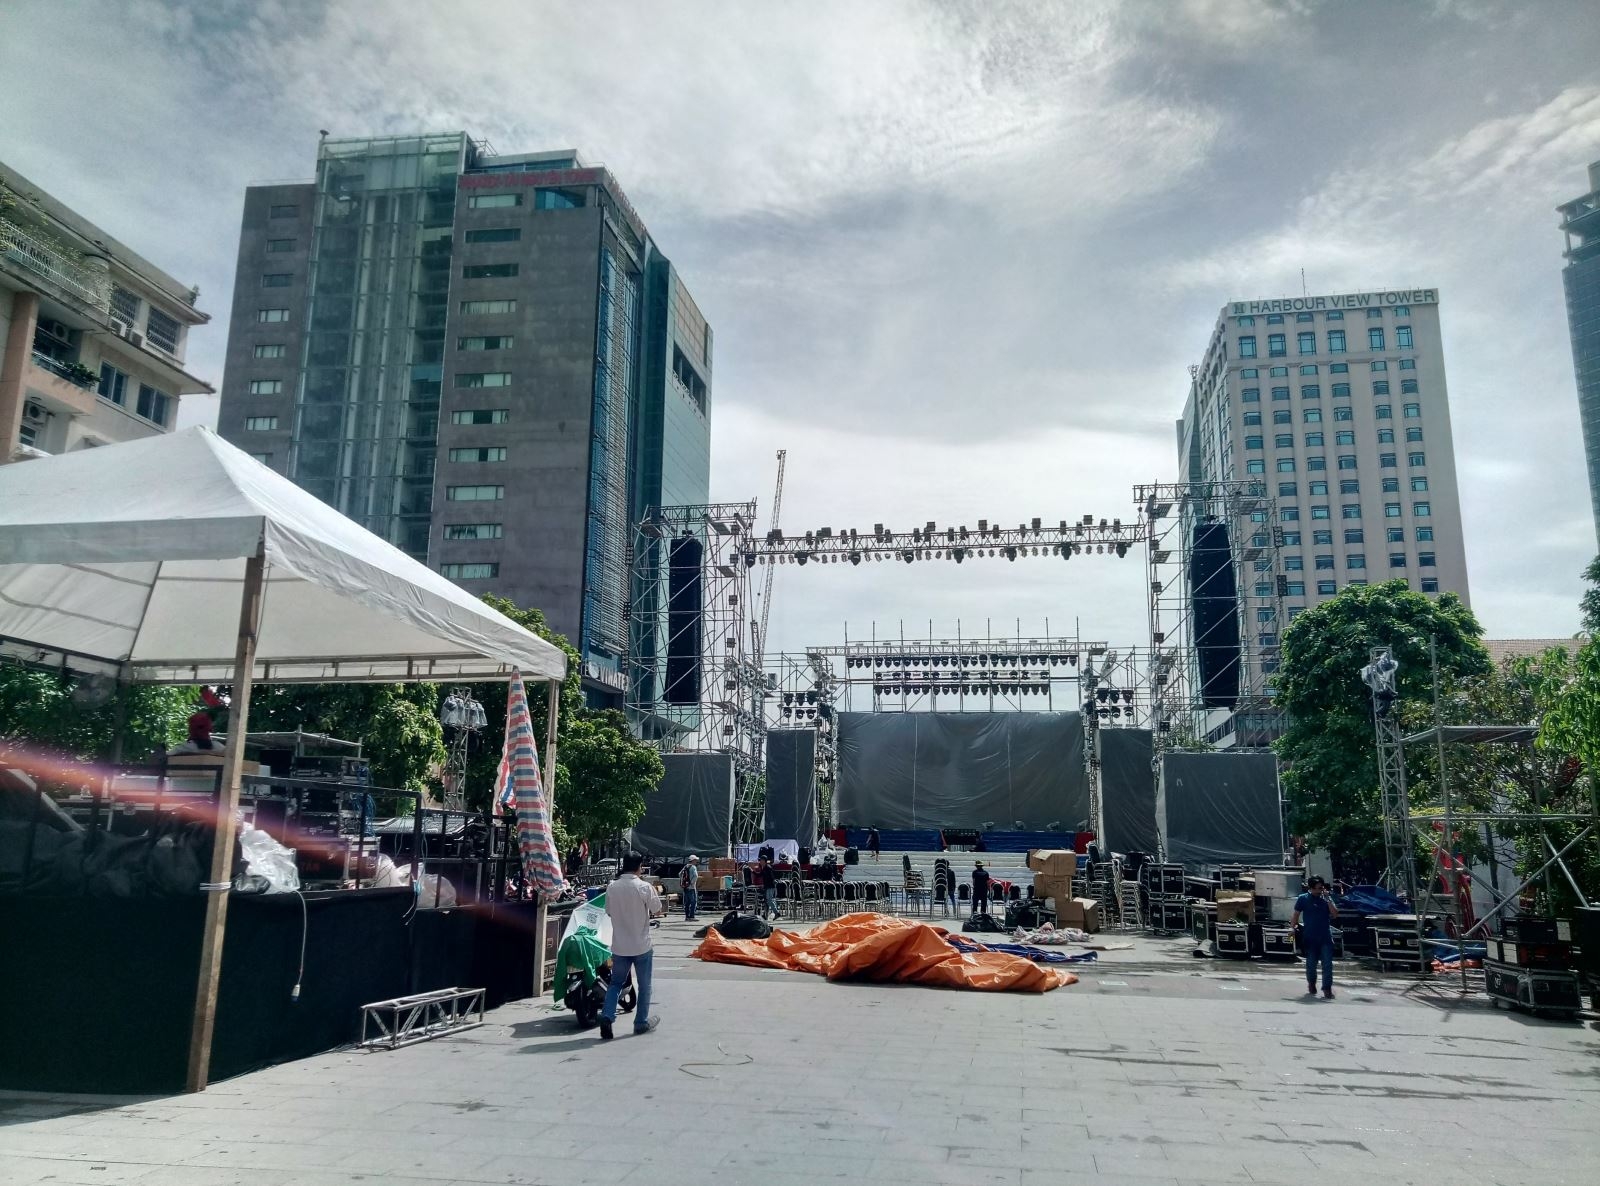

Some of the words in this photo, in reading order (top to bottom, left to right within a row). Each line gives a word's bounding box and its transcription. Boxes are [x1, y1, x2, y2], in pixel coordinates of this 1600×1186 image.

[1250, 297, 1326, 313] HARBOUR
[1330, 294, 1371, 308] VIEW
[1375, 290, 1435, 306] TOWER
